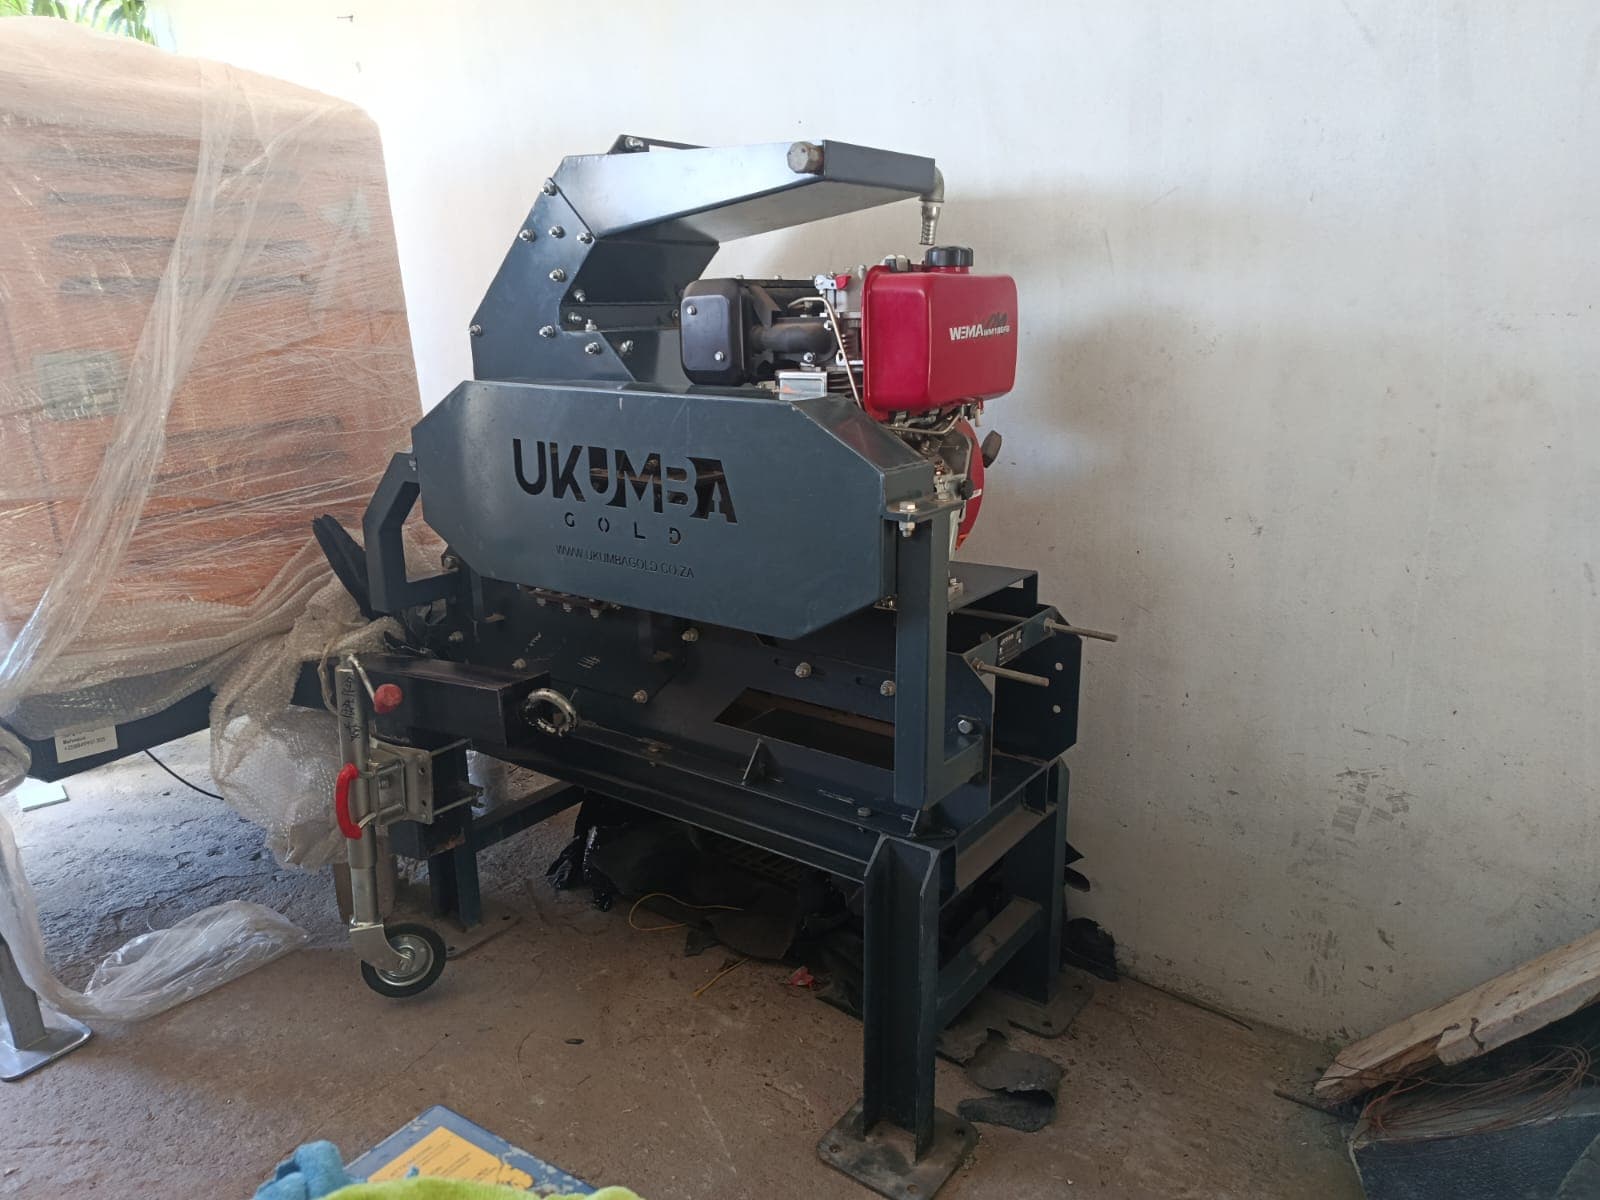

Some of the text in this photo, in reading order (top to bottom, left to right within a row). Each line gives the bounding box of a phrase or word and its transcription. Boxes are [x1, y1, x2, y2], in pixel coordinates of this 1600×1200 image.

[949, 324, 983, 341] WEMA
[512, 438, 738, 524] UKUMBA
[564, 511, 682, 545] GOLD
[555, 544, 695, 579] WWW.UKUMBAGOLD.CO.ZA
